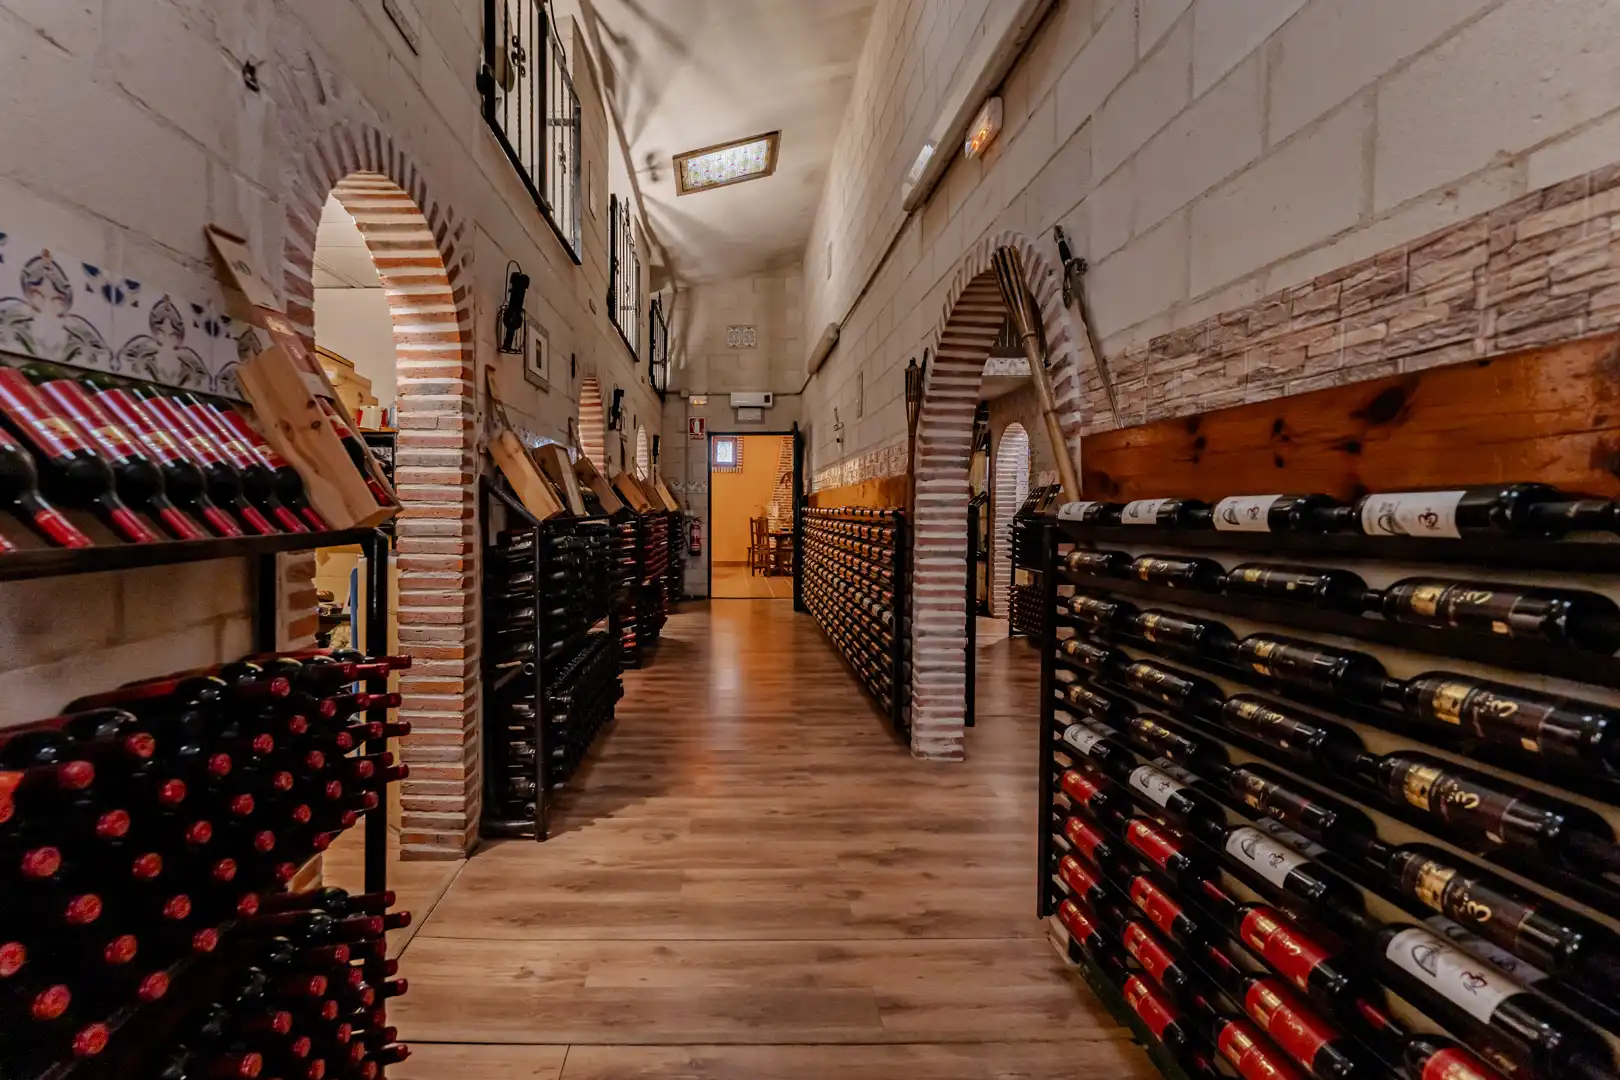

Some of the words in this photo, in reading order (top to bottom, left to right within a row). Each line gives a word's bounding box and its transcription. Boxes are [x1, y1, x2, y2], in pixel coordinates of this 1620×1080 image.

[1490, 700, 1518, 717] 3
[1455, 791, 1480, 809] 3
[1467, 902, 1492, 922] 3
